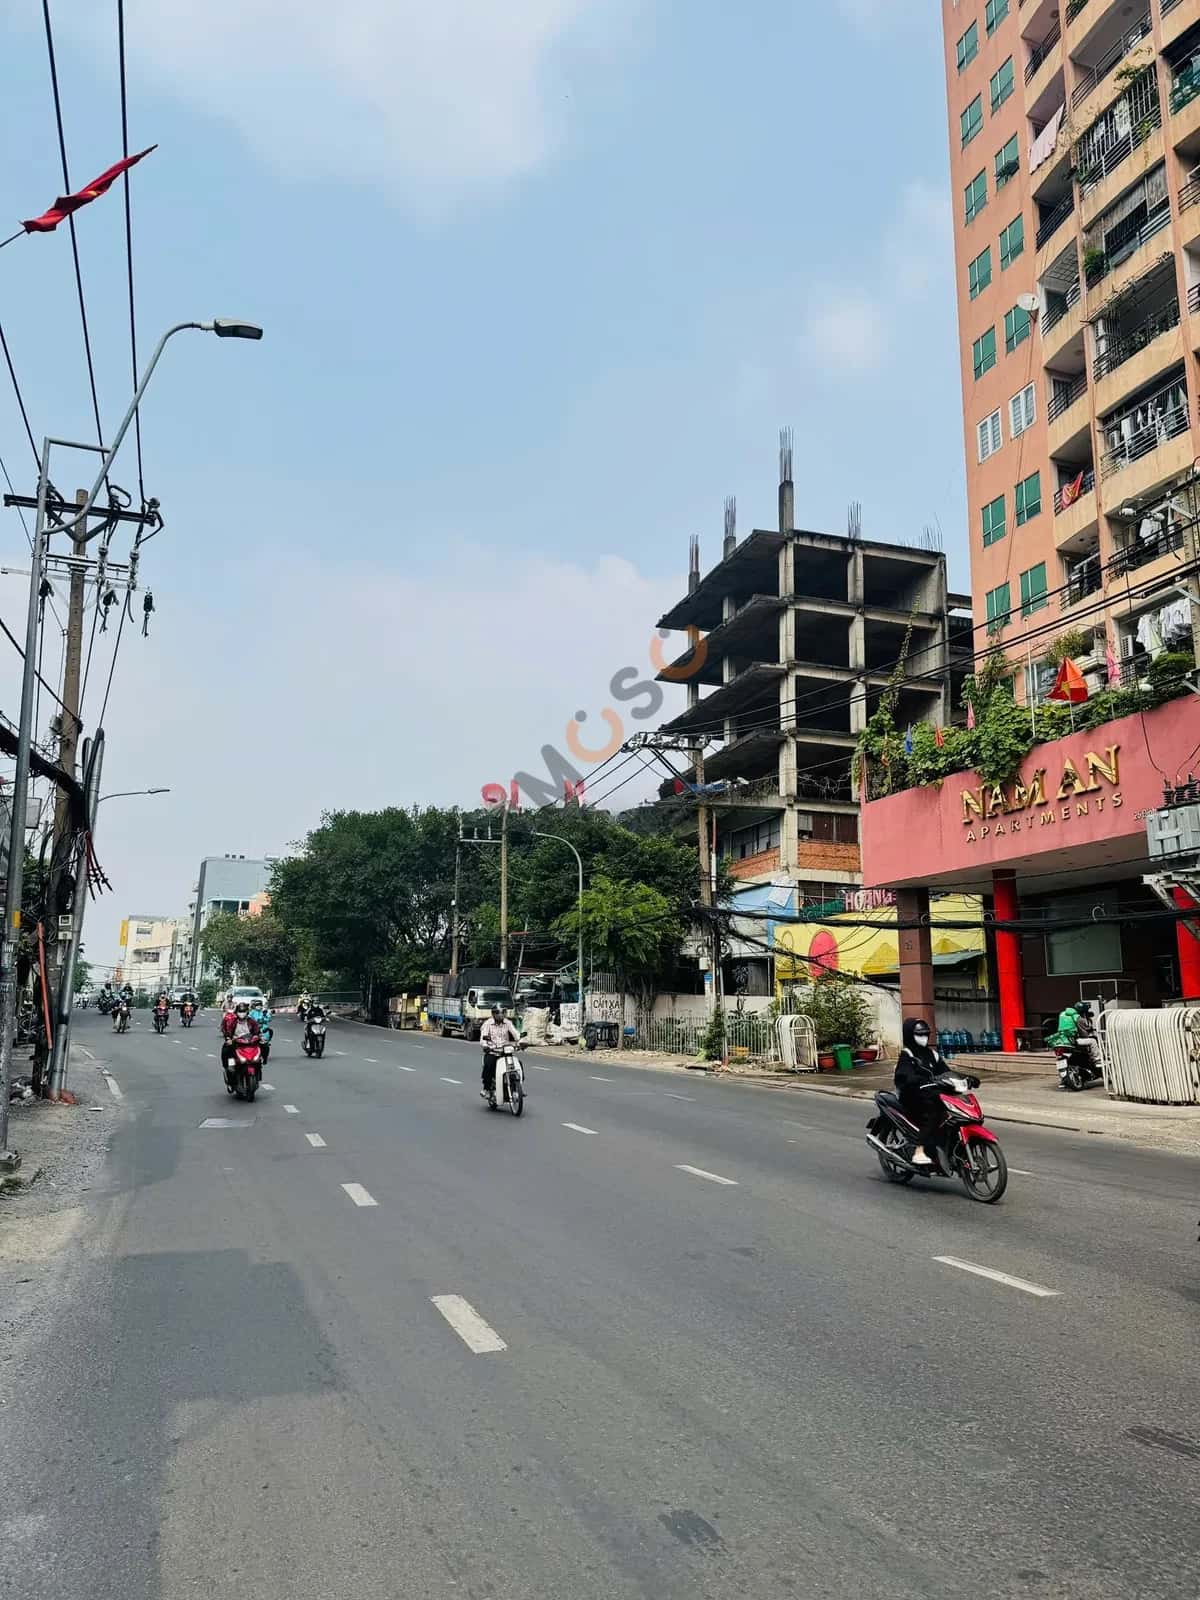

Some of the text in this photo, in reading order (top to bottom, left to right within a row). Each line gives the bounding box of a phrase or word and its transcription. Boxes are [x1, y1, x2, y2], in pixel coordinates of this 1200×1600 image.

[960, 744, 1121, 825] NAM AN
[966, 792, 1123, 843] APARTMENTS
